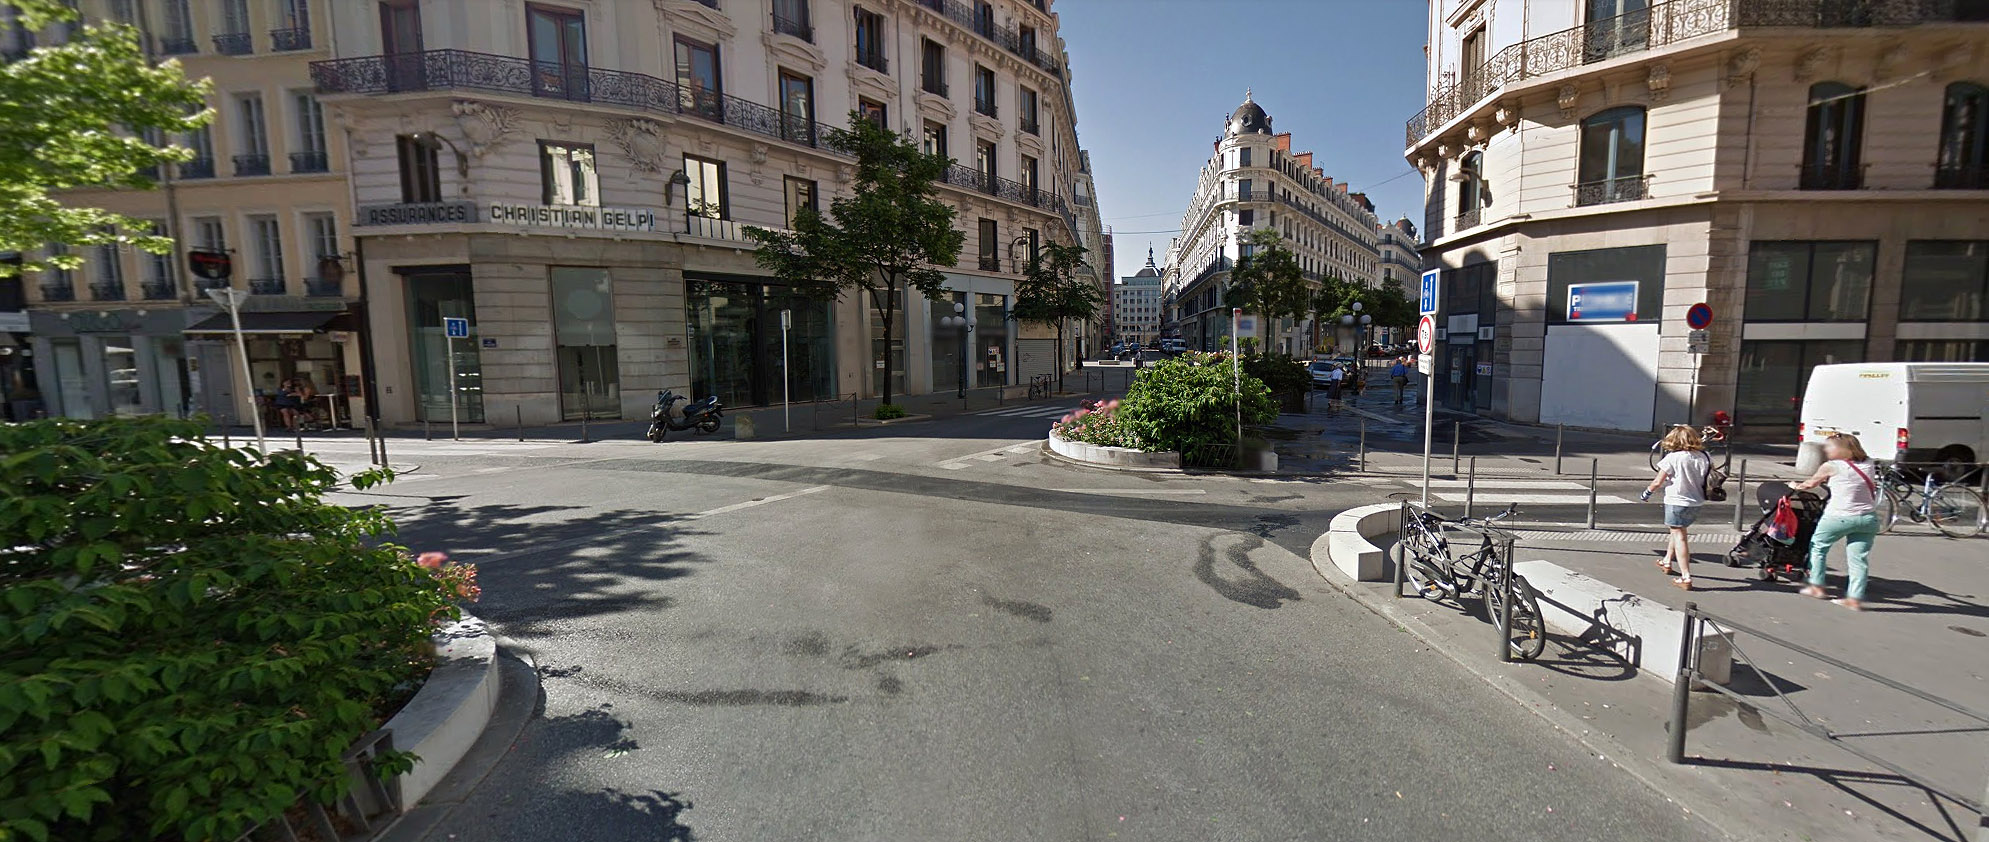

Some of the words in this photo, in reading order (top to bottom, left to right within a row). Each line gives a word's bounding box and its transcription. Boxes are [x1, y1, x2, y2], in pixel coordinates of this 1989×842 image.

[370, 204, 465, 225] ASSURANCES
[491, 206, 595, 225] CHRISTIAN
[603, 210, 654, 227] GELPI
